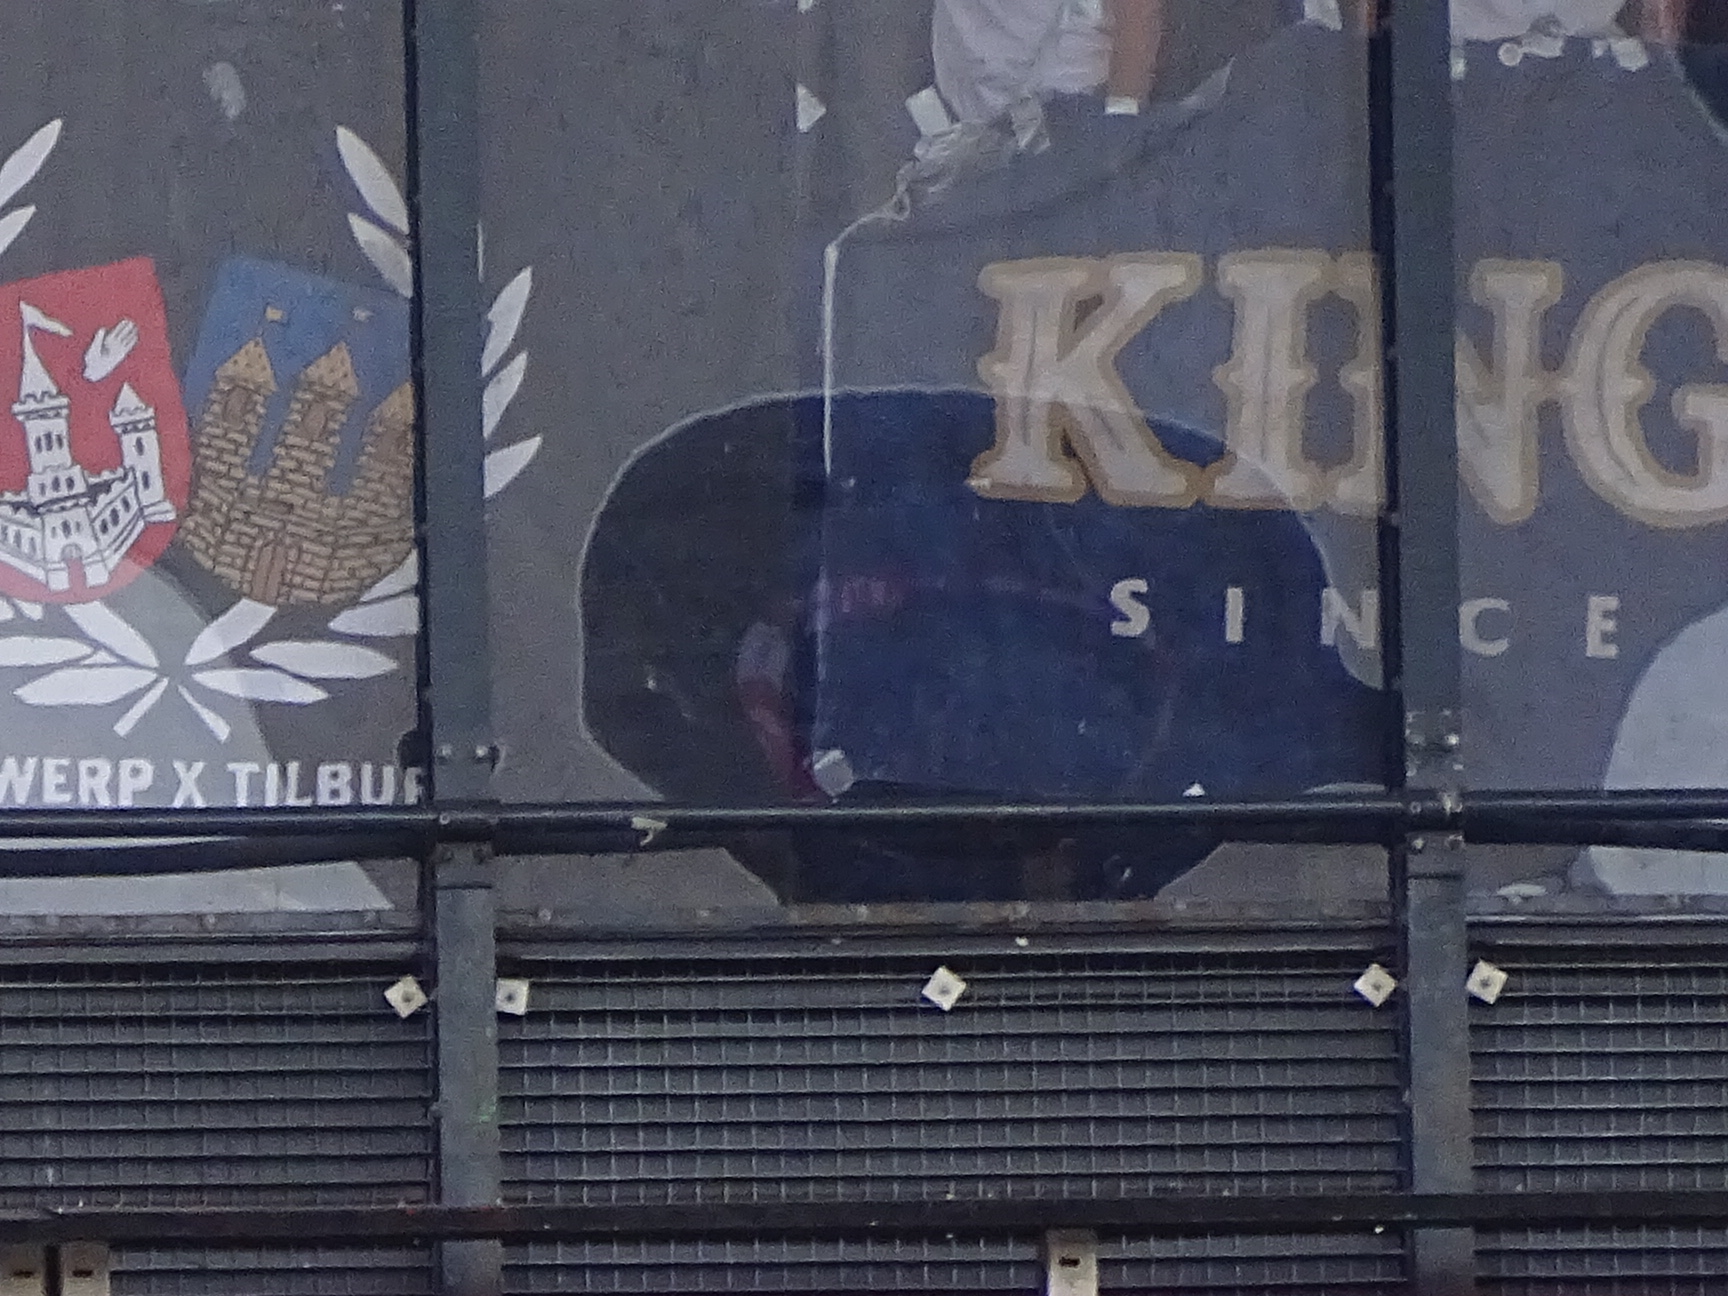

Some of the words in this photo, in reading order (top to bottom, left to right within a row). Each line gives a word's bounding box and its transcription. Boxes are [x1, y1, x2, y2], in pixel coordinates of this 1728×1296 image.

[965, 248, 1728, 528] KING
[1109, 578, 1619, 660] SINCE
[171, 761, 206, 807] X
